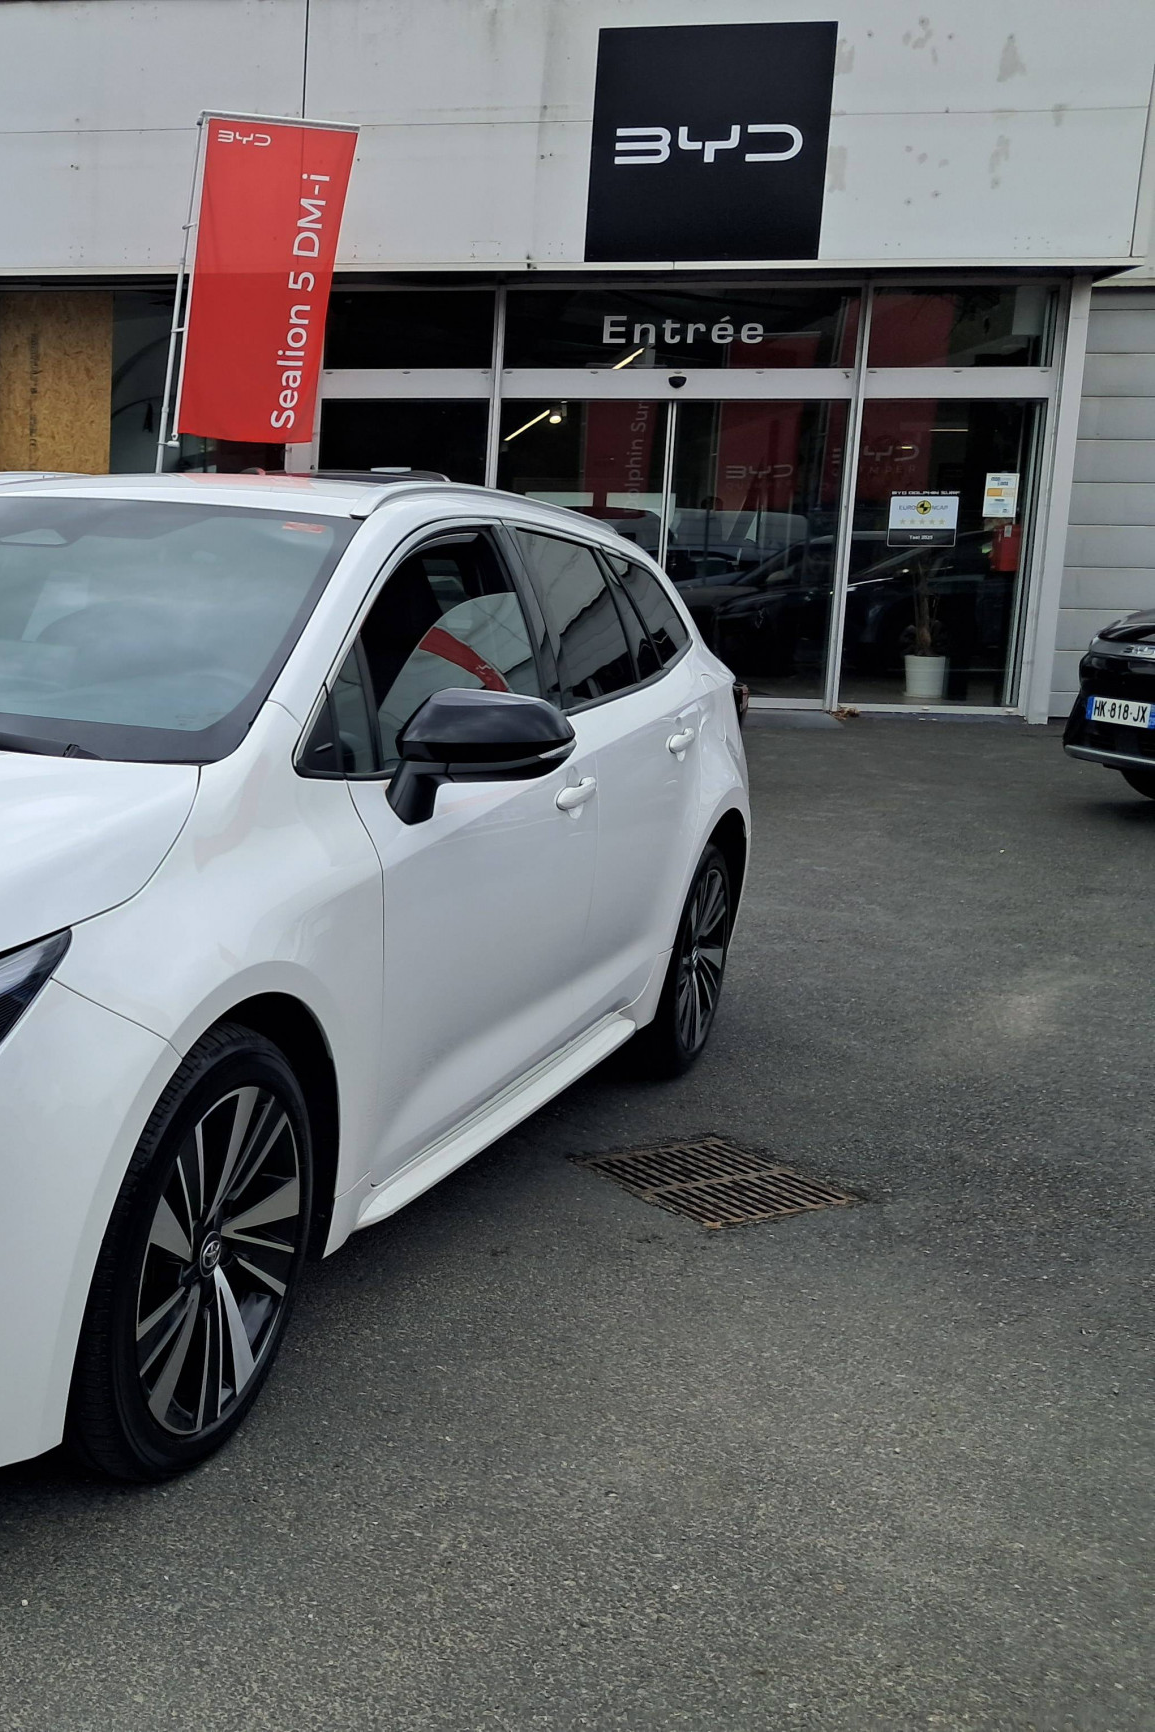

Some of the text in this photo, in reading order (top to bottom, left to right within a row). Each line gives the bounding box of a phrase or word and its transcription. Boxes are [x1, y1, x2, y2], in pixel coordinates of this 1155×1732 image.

[217, 129, 272, 147] BYD
[613, 123, 804, 166] BYD
[270, 173, 331, 429] Sealion 5 DM-i
[602, 314, 766, 346] Entrée
